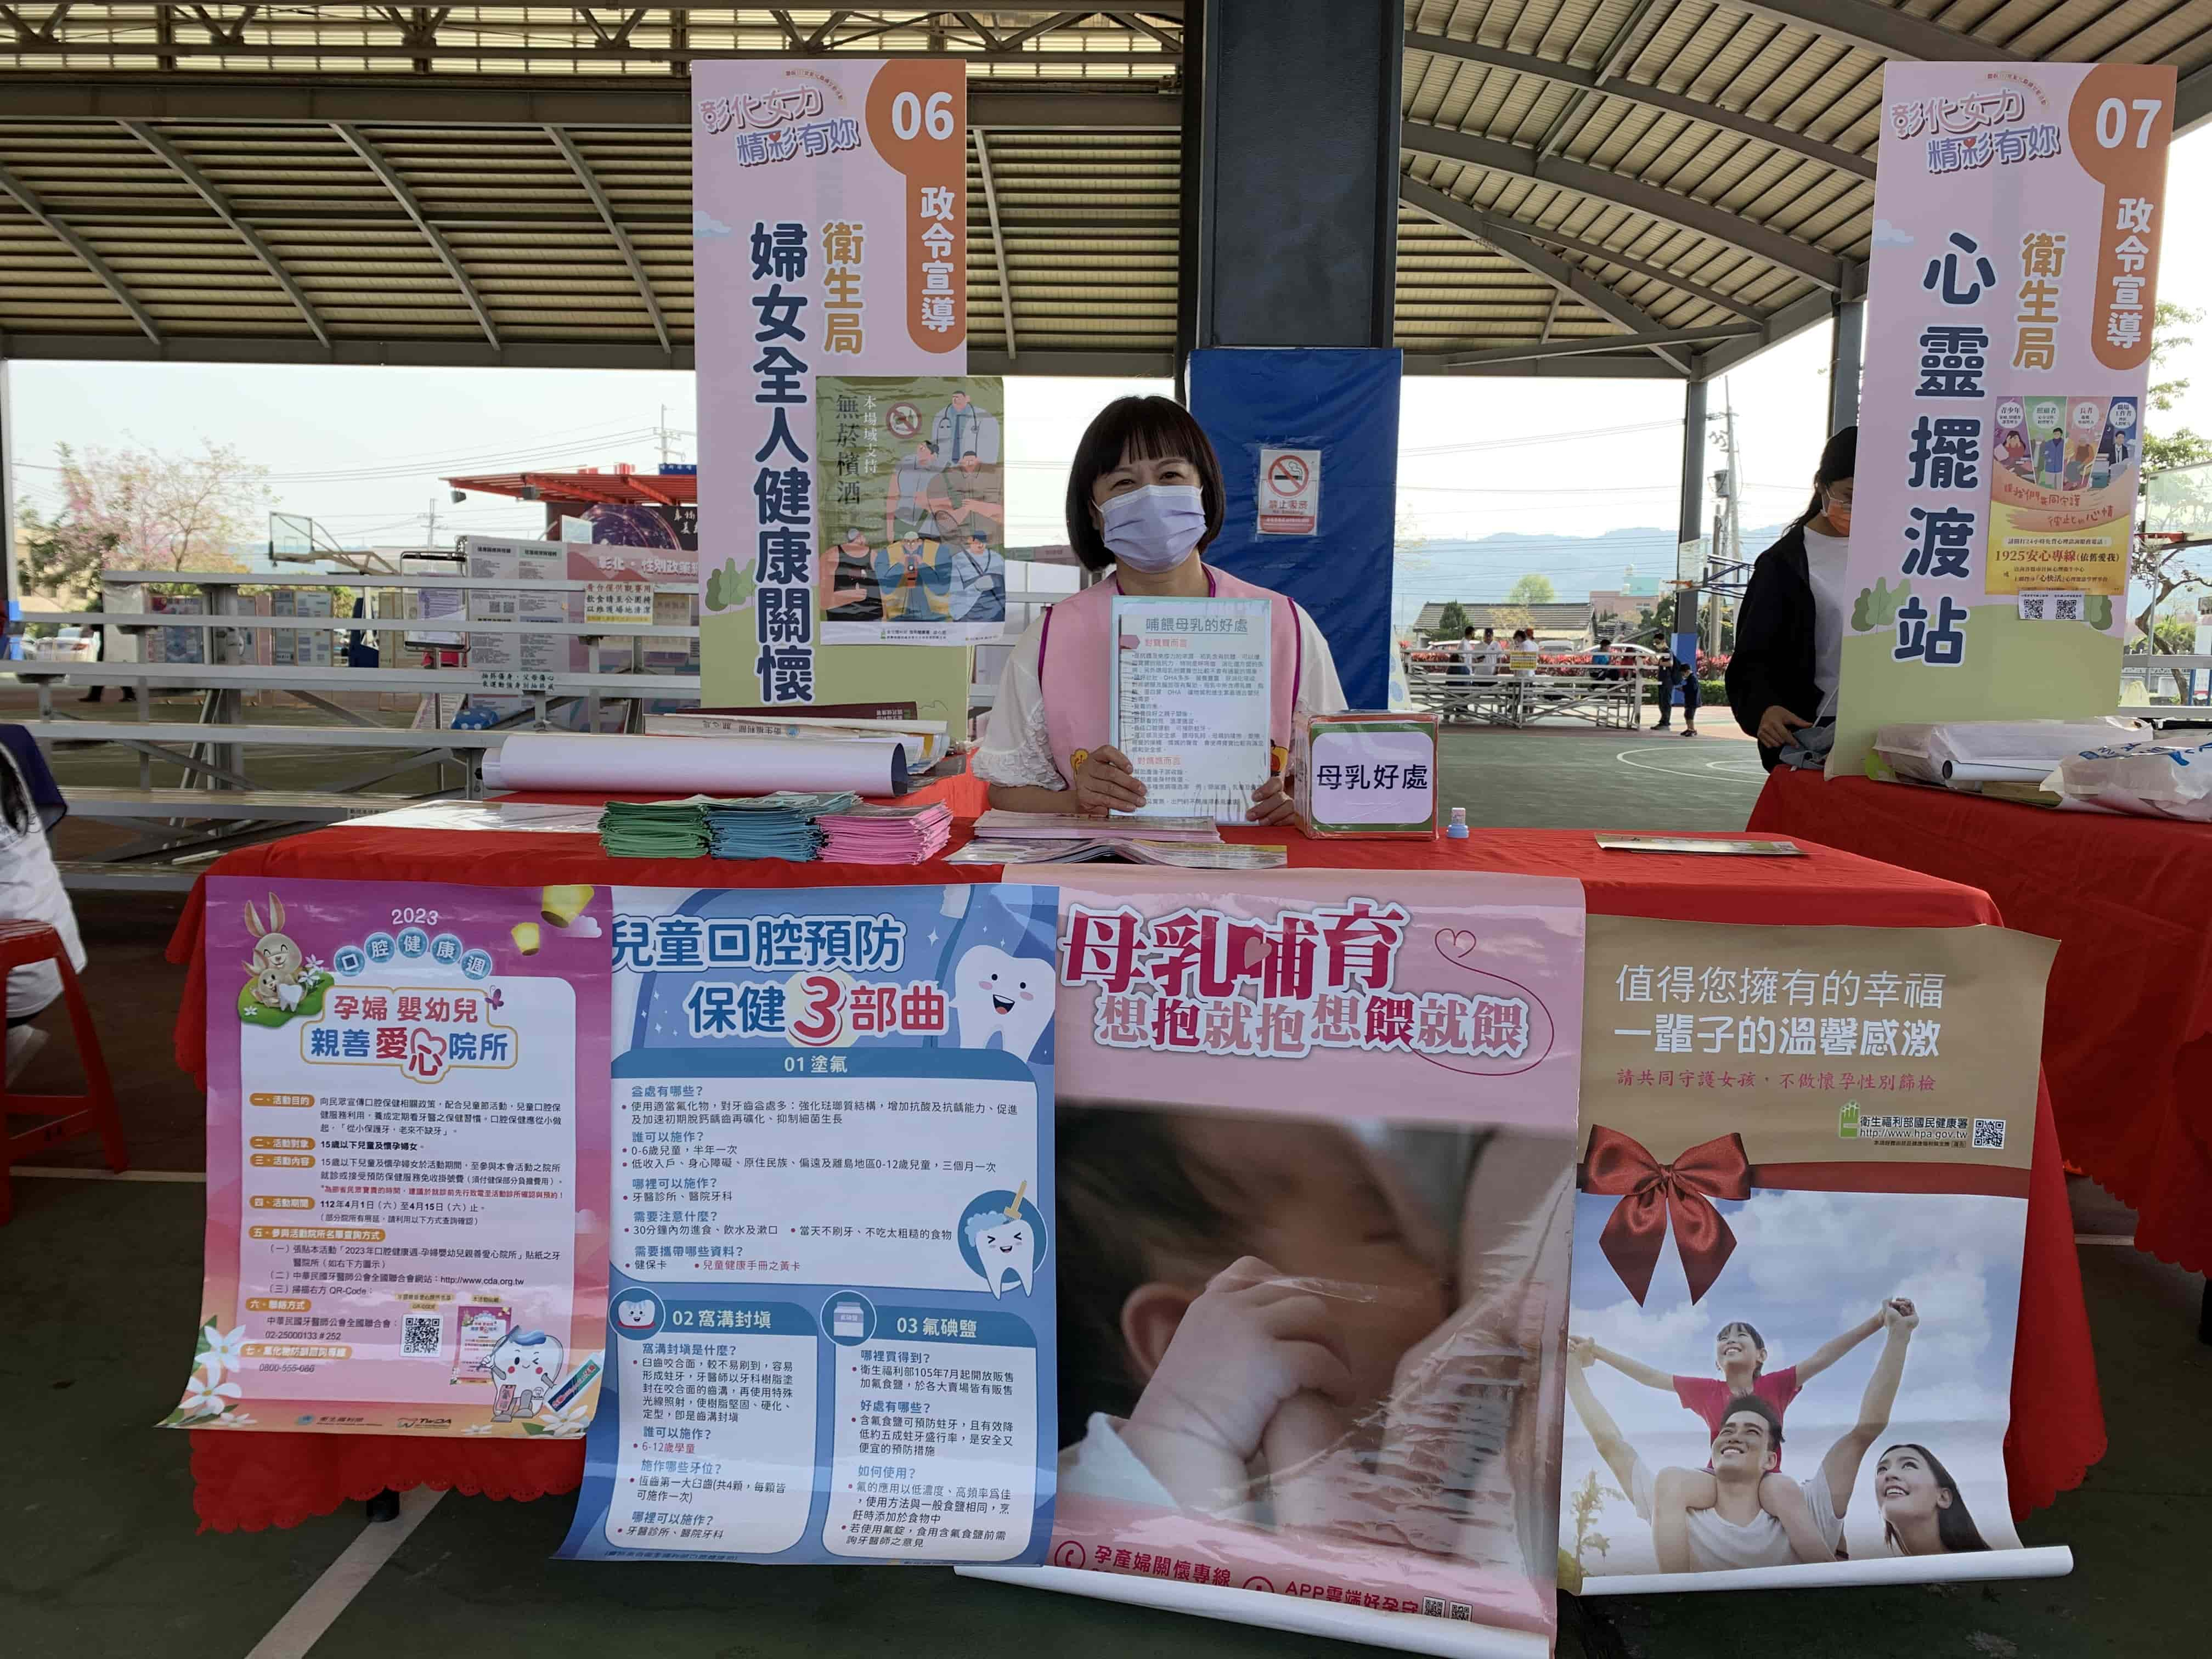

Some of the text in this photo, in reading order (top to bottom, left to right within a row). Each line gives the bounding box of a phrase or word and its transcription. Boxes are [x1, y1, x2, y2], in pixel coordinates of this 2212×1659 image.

[699, 85, 823, 133] 彰化女力
[891, 92, 954, 140] 06
[1891, 89, 2024, 139] 彰化女力
[2096, 98, 2162, 149] 07
[737, 118, 860, 166] 精彩有妳
[1928, 125, 2061, 174] 精彩有妳
[921, 187, 955, 332] 政令宣導
[2106, 198, 2154, 349] 政令宣導
[822, 223, 864, 354] 衛生局
[2013, 233, 2065, 370] 衛生局
[864, 395, 878, 474] 本場域支持
[836, 395, 860, 505] 無菸檳酒
[1893, 233, 1996, 664] 心靈擺渡站
[751, 223, 813, 702] 婦女全人健康關懷
[642, 558, 698, 575] 性別政策
[1146, 618, 1248, 633] 哺餵母乳的好處
[1317, 764, 1429, 791] 母乳好處
[391, 908, 439, 926] 2023
[341, 934, 485, 975] 口腔健康週
[613, 919, 905, 968] 兒童口腔預防
[1063, 904, 1407, 1000] 母乳哺育
[1615, 964, 1946, 1008] 值得您擁有的幸福
[334, 995, 478, 1023] 孕婦 嬰幼兒
[688, 975, 944, 1045] 保健3部曲
[1098, 995, 1525, 1052] 想抱就抱想餵就餵
[1615, 1014, 1940, 1057] 一輩子的溫馨感激
[311, 1026, 508, 1076] 親善愛心院所
[785, 1055, 848, 1073] 01 塗氟
[1617, 1068, 1936, 1092] 請共同守護女孩，不做懷孕性別篩檢
[1860, 1116, 1968, 1128] 衛生福利部國民健康署
[1860, 1129, 1967, 1139] http://www.hpa.gov.tw
[632, 1145, 737, 1155] 0-6歲兒童，半年一次
[633, 1191, 732, 1202] 牙醫診所、醫院牙科
[633, 1225, 952, 1240] 30分鐘內勿進食、飲水及漱口 當天不刷牙、不吃太粗糙的食物
[635, 1260, 800, 1272] 健保卡 兒童健康手冊之黃卡
[673, 1311, 693, 1326] 02
[897, 1318, 977, 1339] 03 氟碘鹽
[642, 1357, 793, 1372] 臼齒咬合面，較不易刷到，容易
[642, 1370, 793, 1385] 形成蛀牙，牙醫師以牙科樹脂塗
[860, 1364, 1014, 1383] 衛生福利部105年7月起開放販售
[642, 1384, 793, 1398] 封在咬合面的齒溝，再使用特殊
[860, 1378, 1013, 1396] 加氟食鹽，於各大賣場皆有販售
[642, 1396, 790, 1412] 光線照射，使樹脂堅固、硬化、
[860, 1415, 1013, 1433] 含氟食鹽可預防蛀牙，且有效降
[642, 1441, 695, 1454] 6-12歲學童
[859, 1429, 1013, 1447] 低約五成蛀牙盛行率，是安全又
[859, 1442, 935, 1457] 便宜的預防措施
[626, 1526, 724, 1539] 牙醫診所、醫院牙科
[1094, 1545, 1231, 1587] 孕產婦關懷專線
